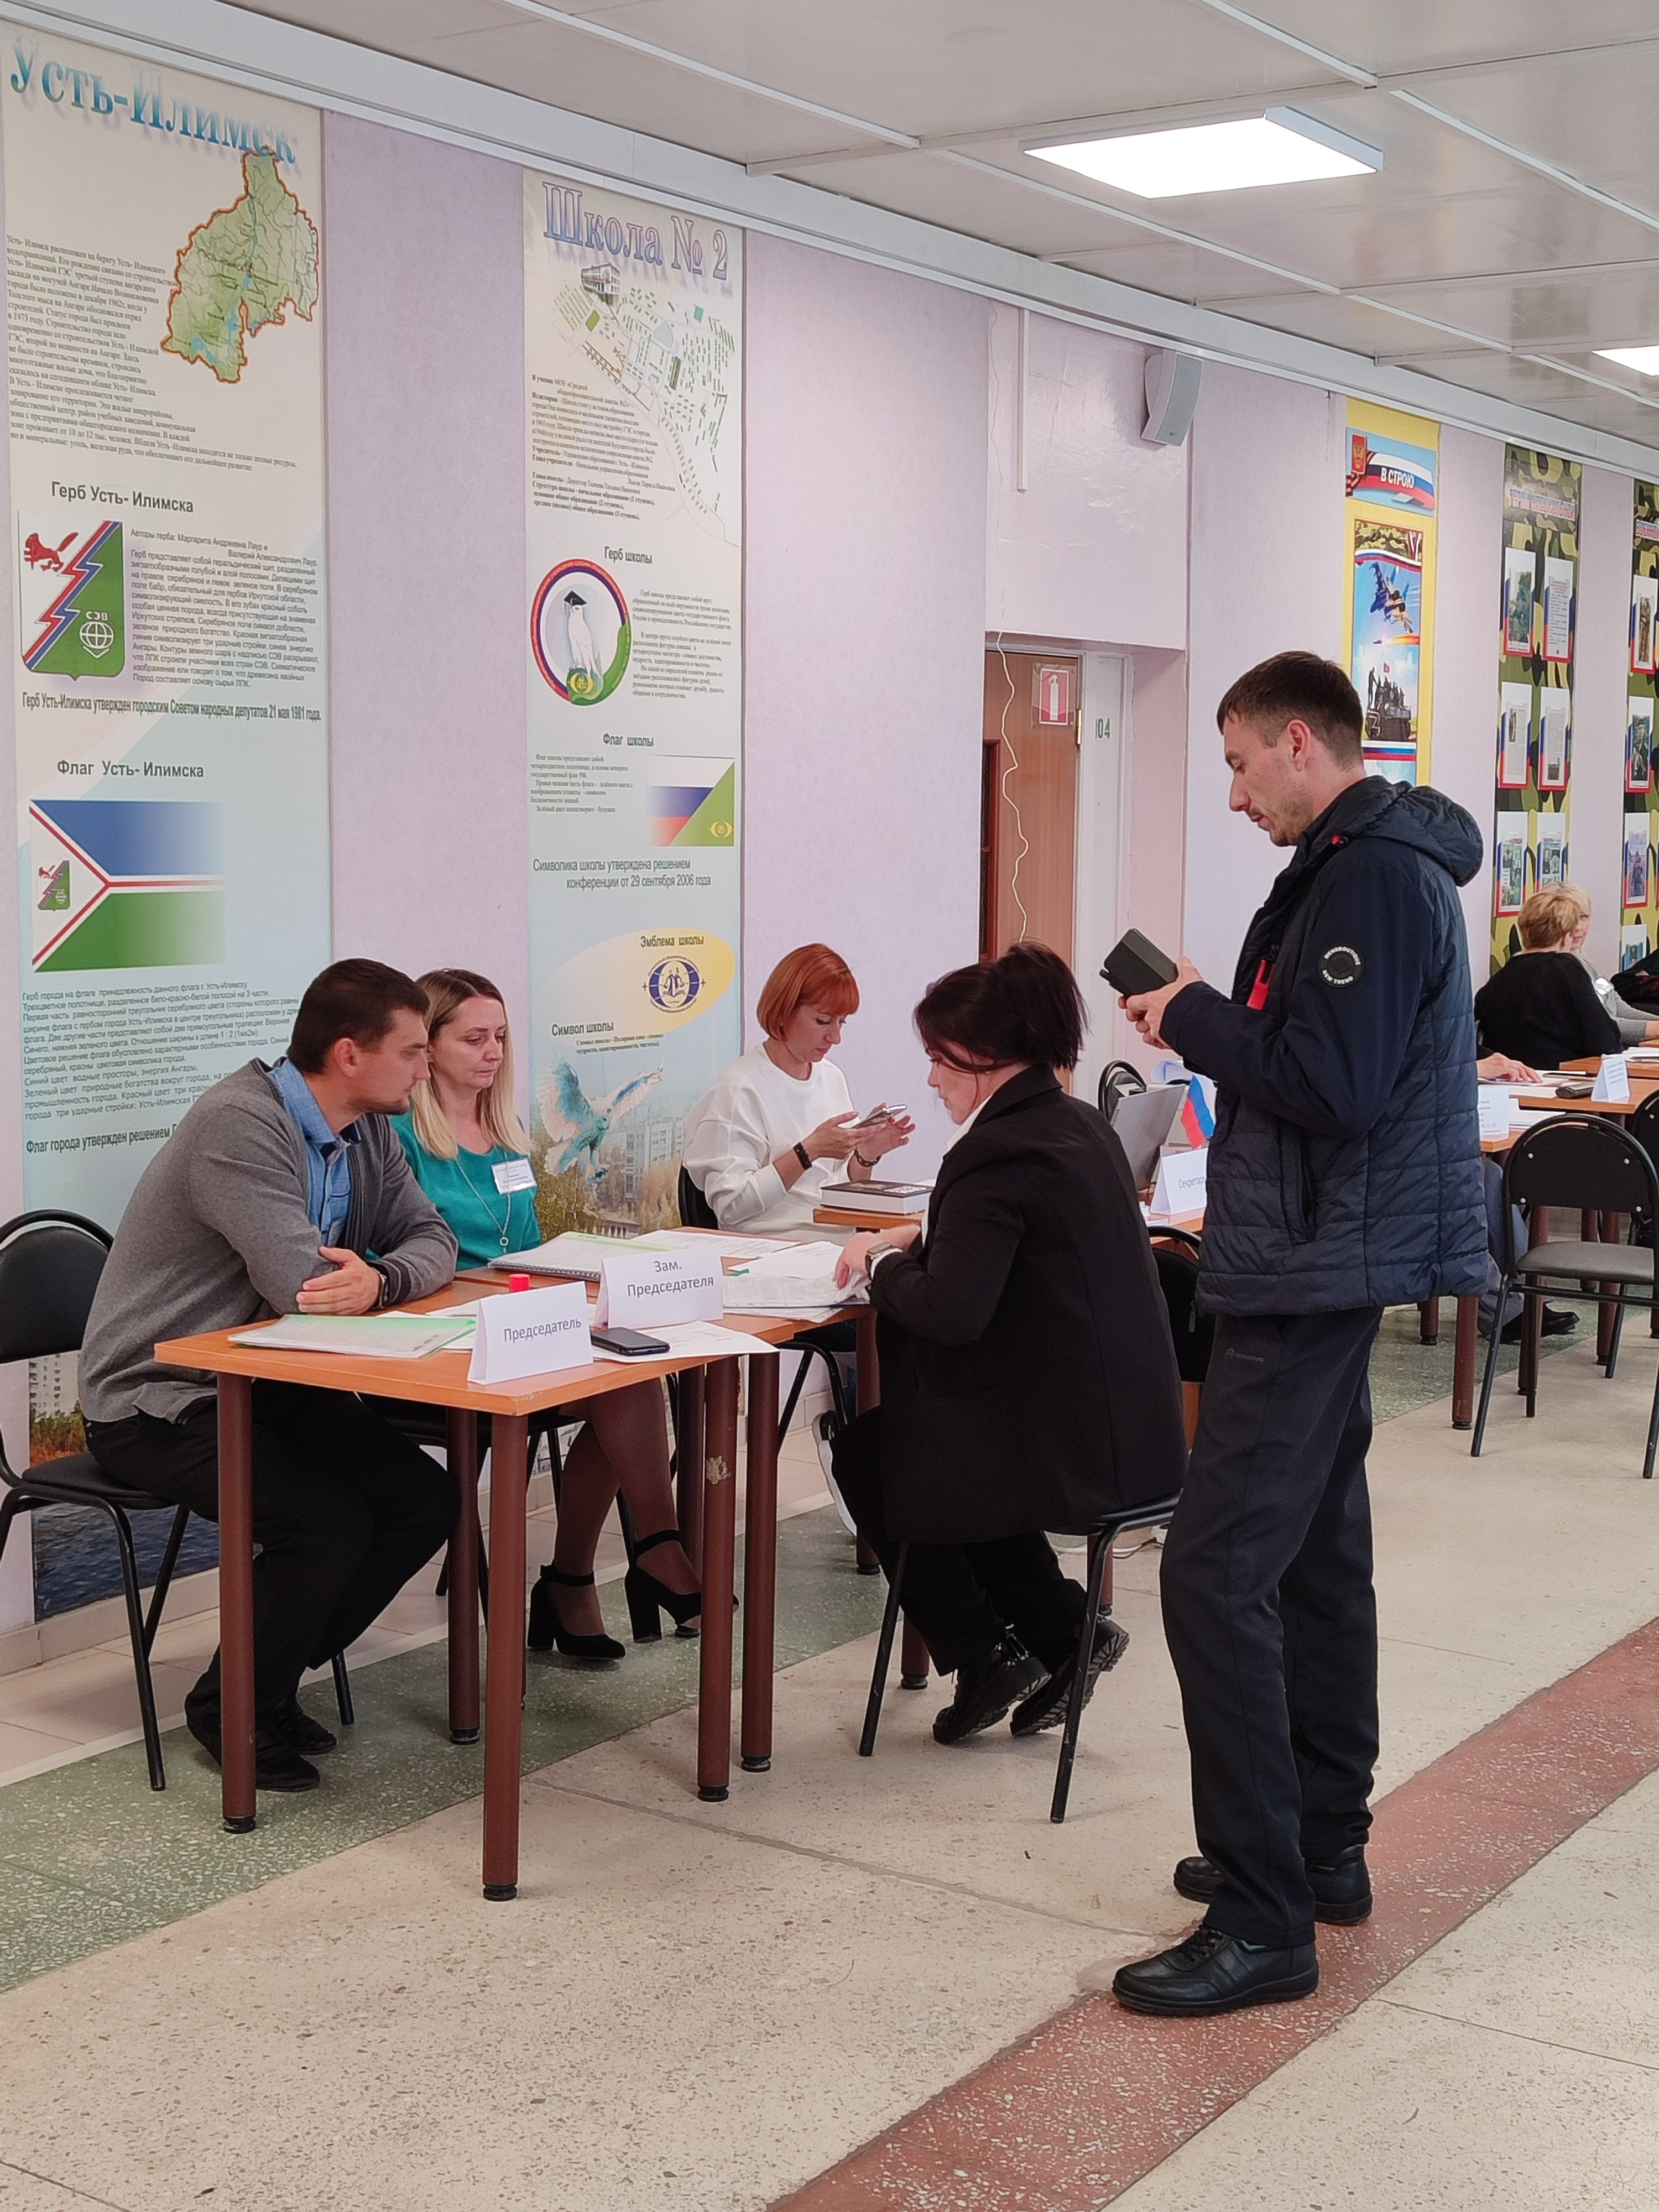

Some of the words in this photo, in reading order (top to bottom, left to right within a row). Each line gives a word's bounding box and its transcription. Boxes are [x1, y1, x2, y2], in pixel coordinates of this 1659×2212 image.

[9, 34, 296, 164] Усть-Илимск
[542, 181, 662, 265] Школа
[671, 215, 703, 275] №
[713, 229, 727, 280] 2
[1380, 467, 1387, 482] В
[1388, 469, 1415, 489] СТРОЮ
[52, 481, 86, 502] Герб
[90, 485, 129, 504] Усть-
[133, 491, 194, 513] Илимска
[604, 546, 623, 563] Герб
[625, 552, 652, 564] школы
[86, 611, 108, 620] СЭВ
[22, 692, 40, 711] Герб
[41, 693, 92, 709] Усть-Илимска
[93, 699, 131, 714] утвержден
[132, 700, 169, 716] городским
[170, 699, 199, 714] Советом
[201, 703, 234, 718] народных
[278, 708, 289, 719] мая
[291, 706, 305, 719] 1981
[306, 708, 321, 722] года.
[1095, 718, 1110, 739] 104
[603, 733, 623, 745] Флаг
[627, 737, 654, 747] школы
[58, 759, 94, 775] Флаг
[102, 760, 139, 776] Усть-
[144, 761, 204, 777] Илимска
[533, 859, 577, 871] Символика
[580, 860, 606, 870] школы
[607, 860, 651, 873] утверждена
[653, 860, 690, 872] решением
[567, 877, 618, 891] конференции
[620, 878, 629, 887] от
[630, 875, 640, 887] 29
[641, 875, 675, 889] сентября
[677, 874, 694, 886] 2006
[696, 876, 711, 888] года
[640, 935, 675, 947] Эмблема
[679, 936, 704, 946] школы
[1322, 969, 1333, 981] NEW
[1334, 976, 1353, 984] TREND
[552, 1024, 584, 1036] Символ
[586, 1022, 614, 1033] школы
[27, 1140, 49, 1154] Флаг
[50, 1140, 80, 1153] города
[82, 1132, 127, 1151] утвержден
[129, 1128, 170, 1145] решением
[1178, 1176, 1206, 1189] Секретар
[654, 1260, 682, 1273] Зам.
[627, 1276, 714, 1298] Председателя
[504, 1318, 582, 1343] Председатель
